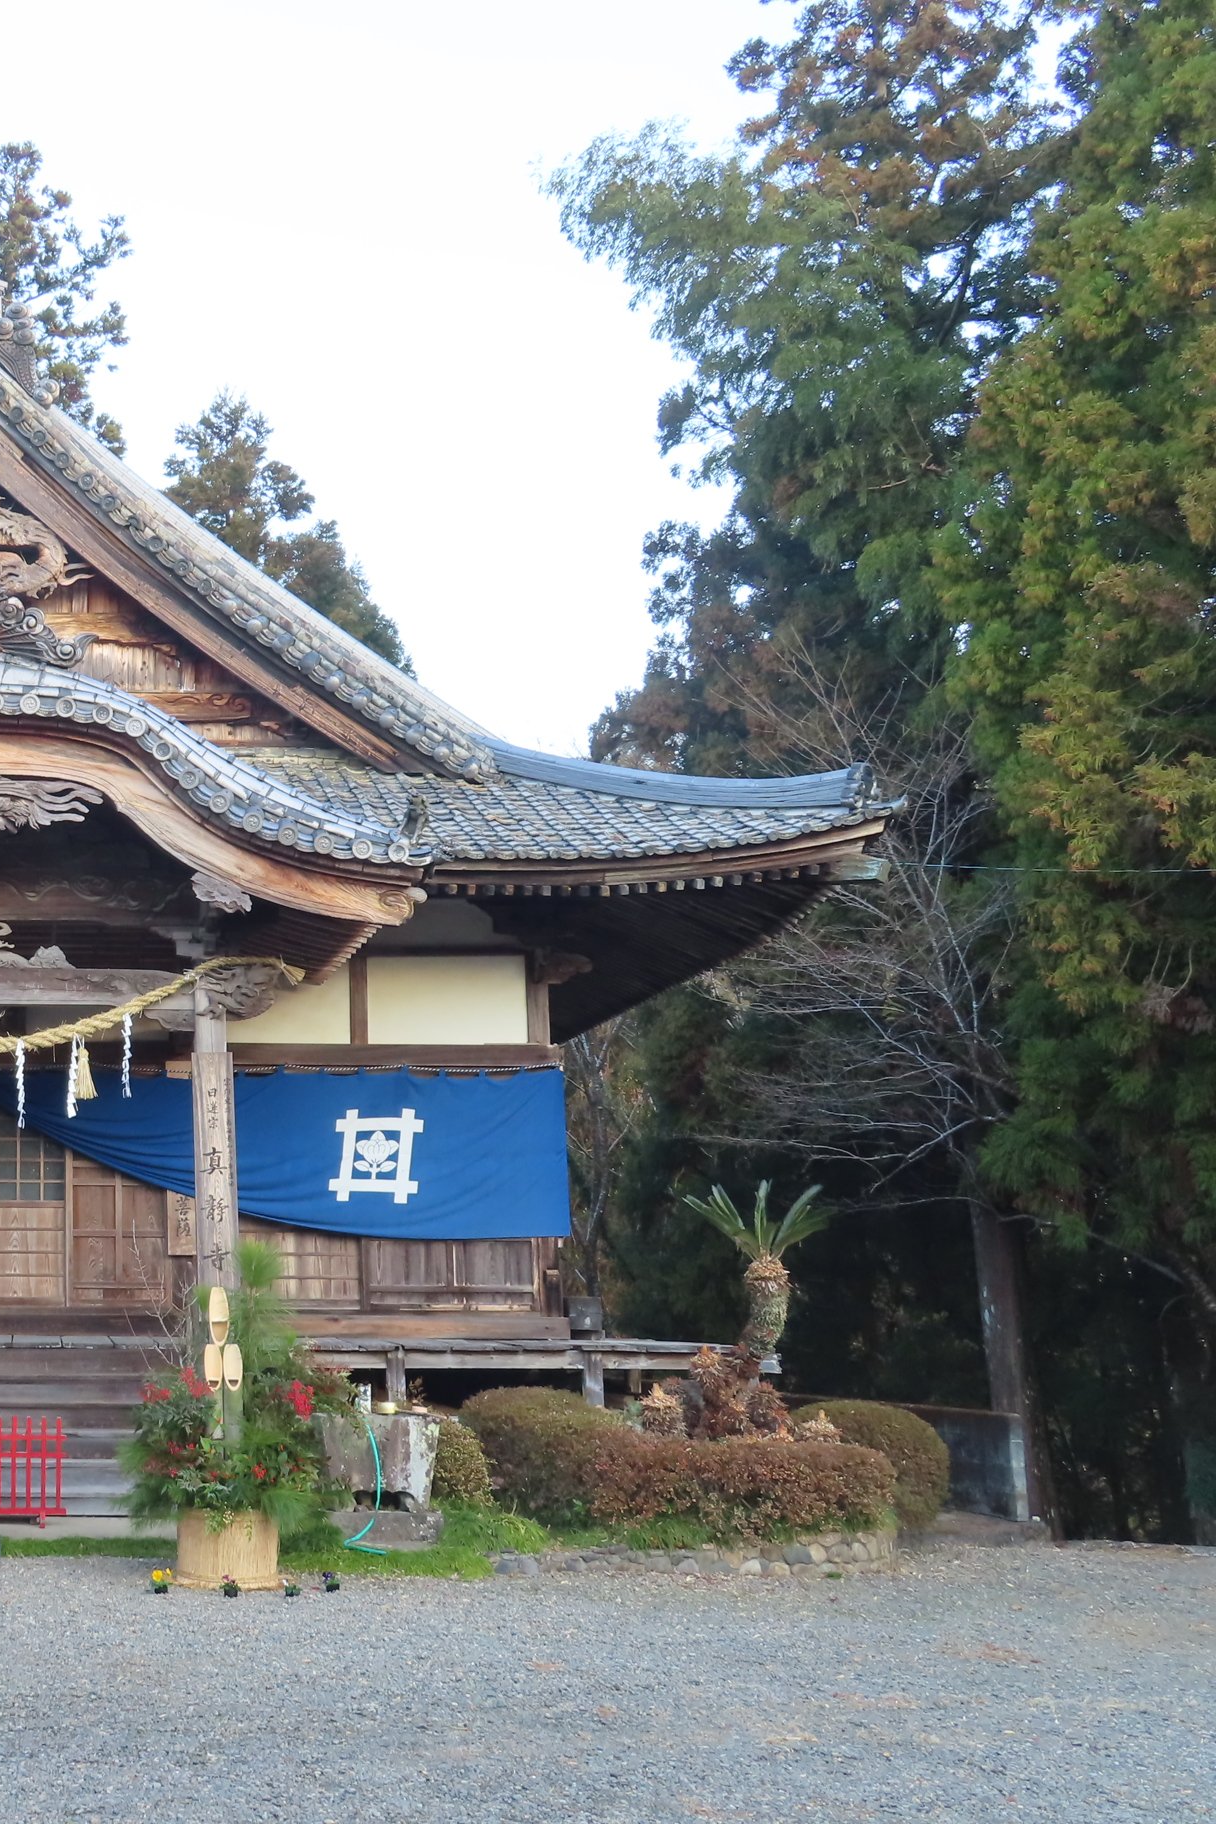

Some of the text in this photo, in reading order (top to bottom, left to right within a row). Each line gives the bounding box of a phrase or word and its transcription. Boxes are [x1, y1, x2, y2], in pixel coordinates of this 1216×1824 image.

[206, 1087, 219, 1129] 日蓮宗
[199, 1146, 231, 1272] 真静寺
